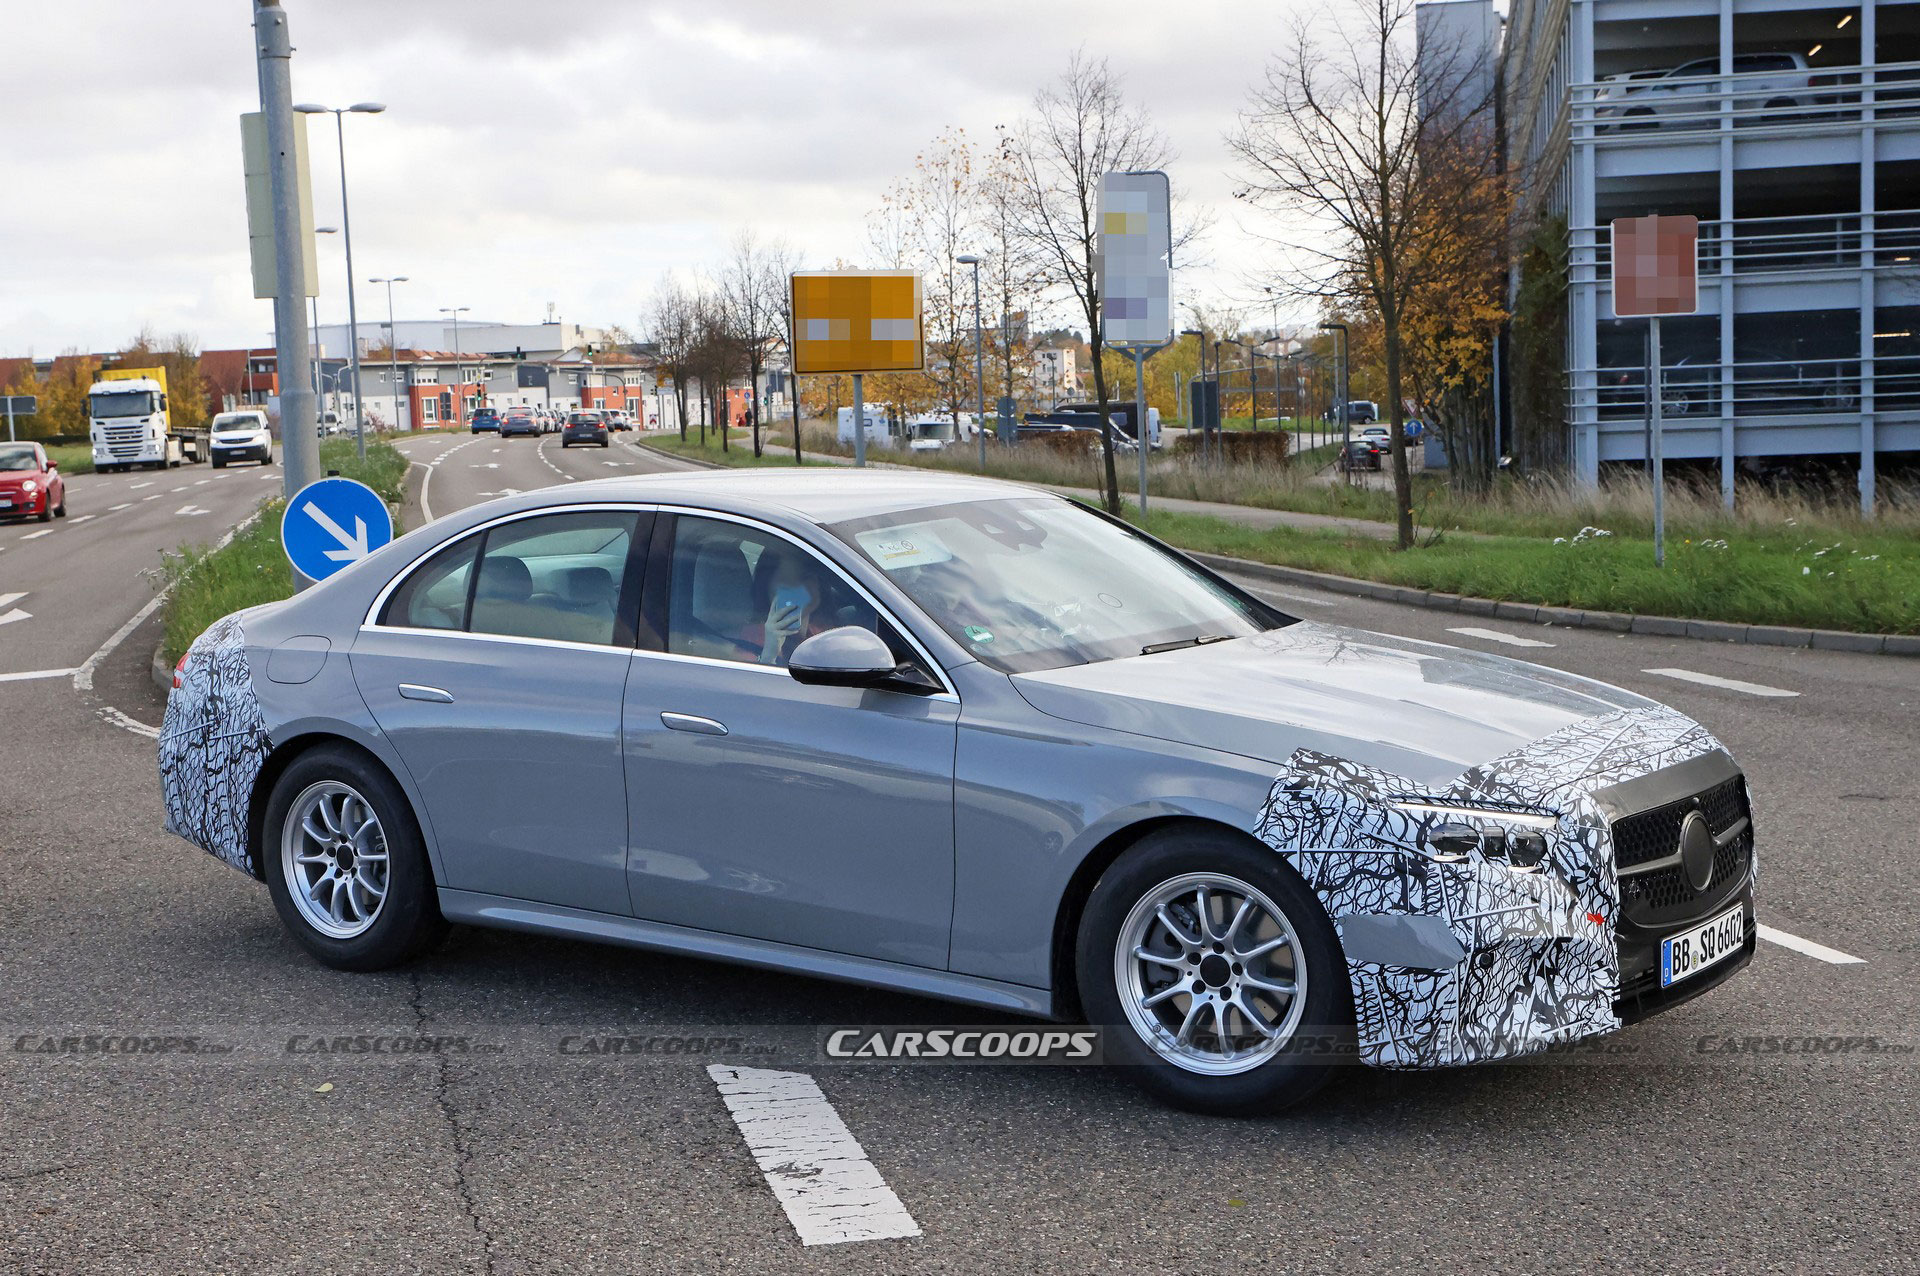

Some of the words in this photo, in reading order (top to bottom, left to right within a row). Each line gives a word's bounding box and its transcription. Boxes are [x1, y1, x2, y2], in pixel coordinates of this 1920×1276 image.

[1672, 938, 1690, 976] BB
[1700, 926, 1716, 963] SQ
[1717, 911, 1742, 954] 6602
